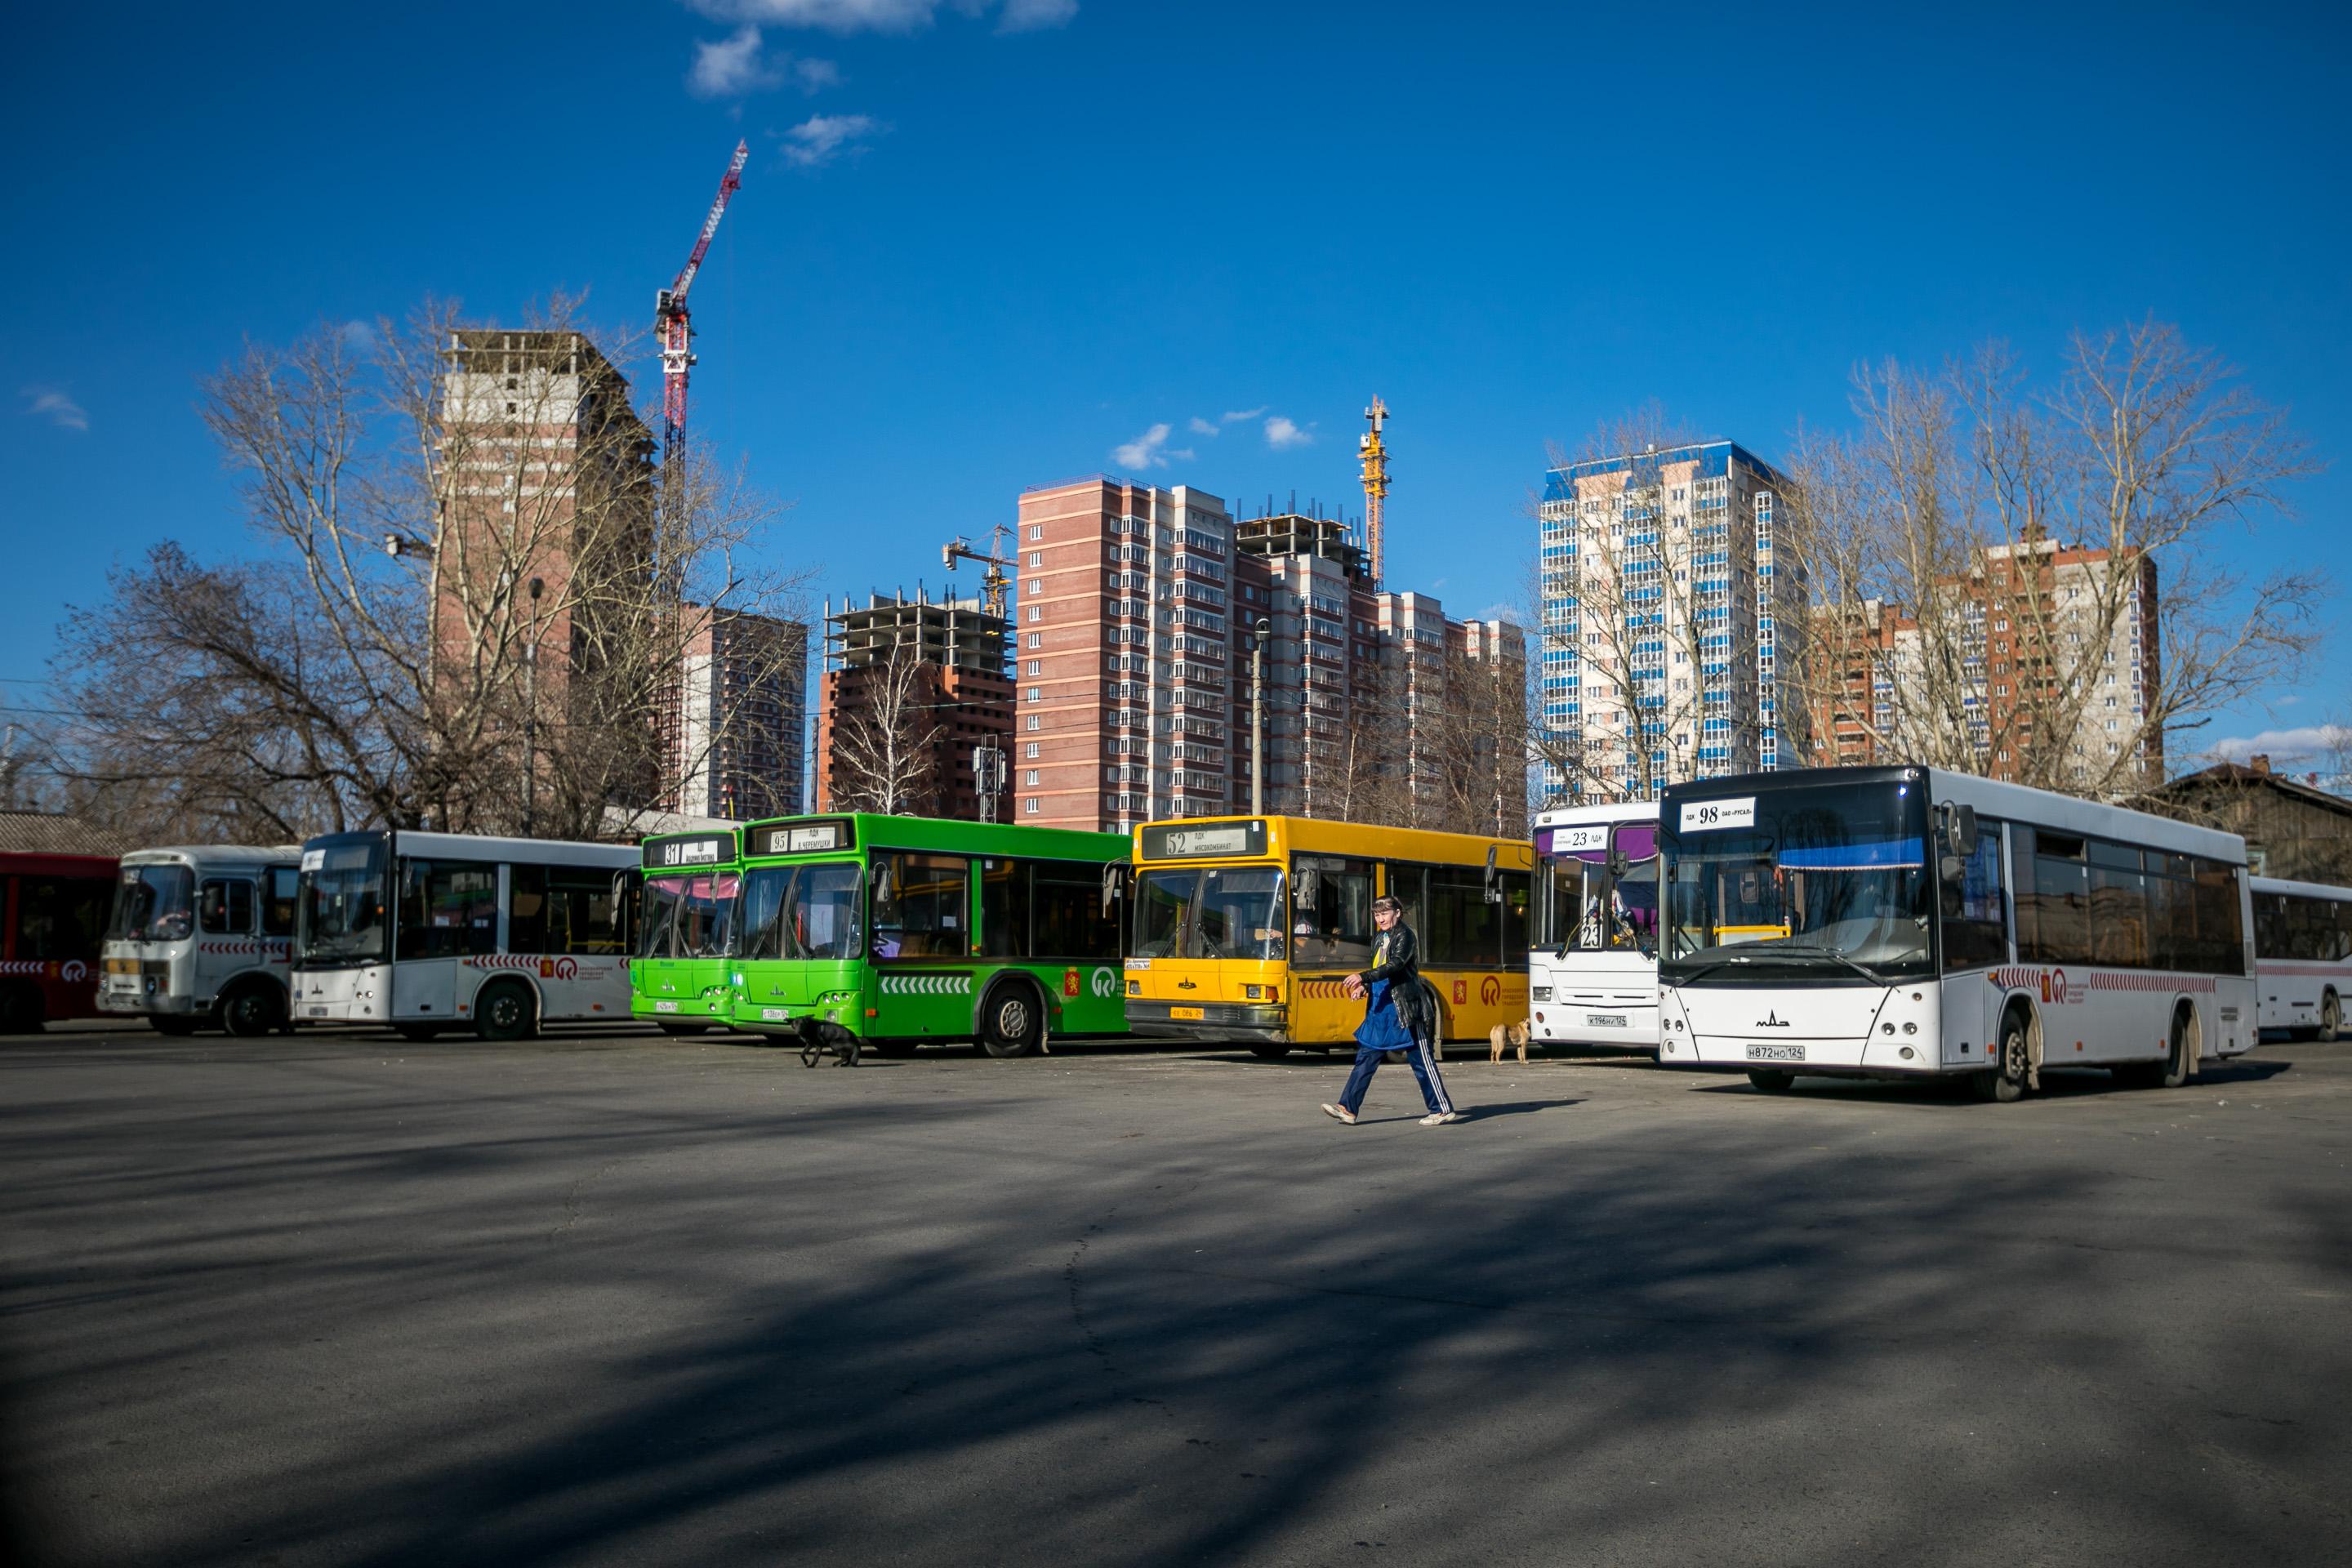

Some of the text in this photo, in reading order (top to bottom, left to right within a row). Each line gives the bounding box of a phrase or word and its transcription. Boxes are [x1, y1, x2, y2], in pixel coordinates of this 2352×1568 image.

[1699, 806, 1718, 825] 98
[774, 835, 785, 849] 95
[1168, 833, 1186, 854] 52
[1572, 831, 1602, 846] 23 ЛДК
[666, 844, 676, 863] 31
[1194, 842, 1232, 851] МЯСОКОМБИНАТ
[1748, 1047, 1802, 1058] Н872НО 124
